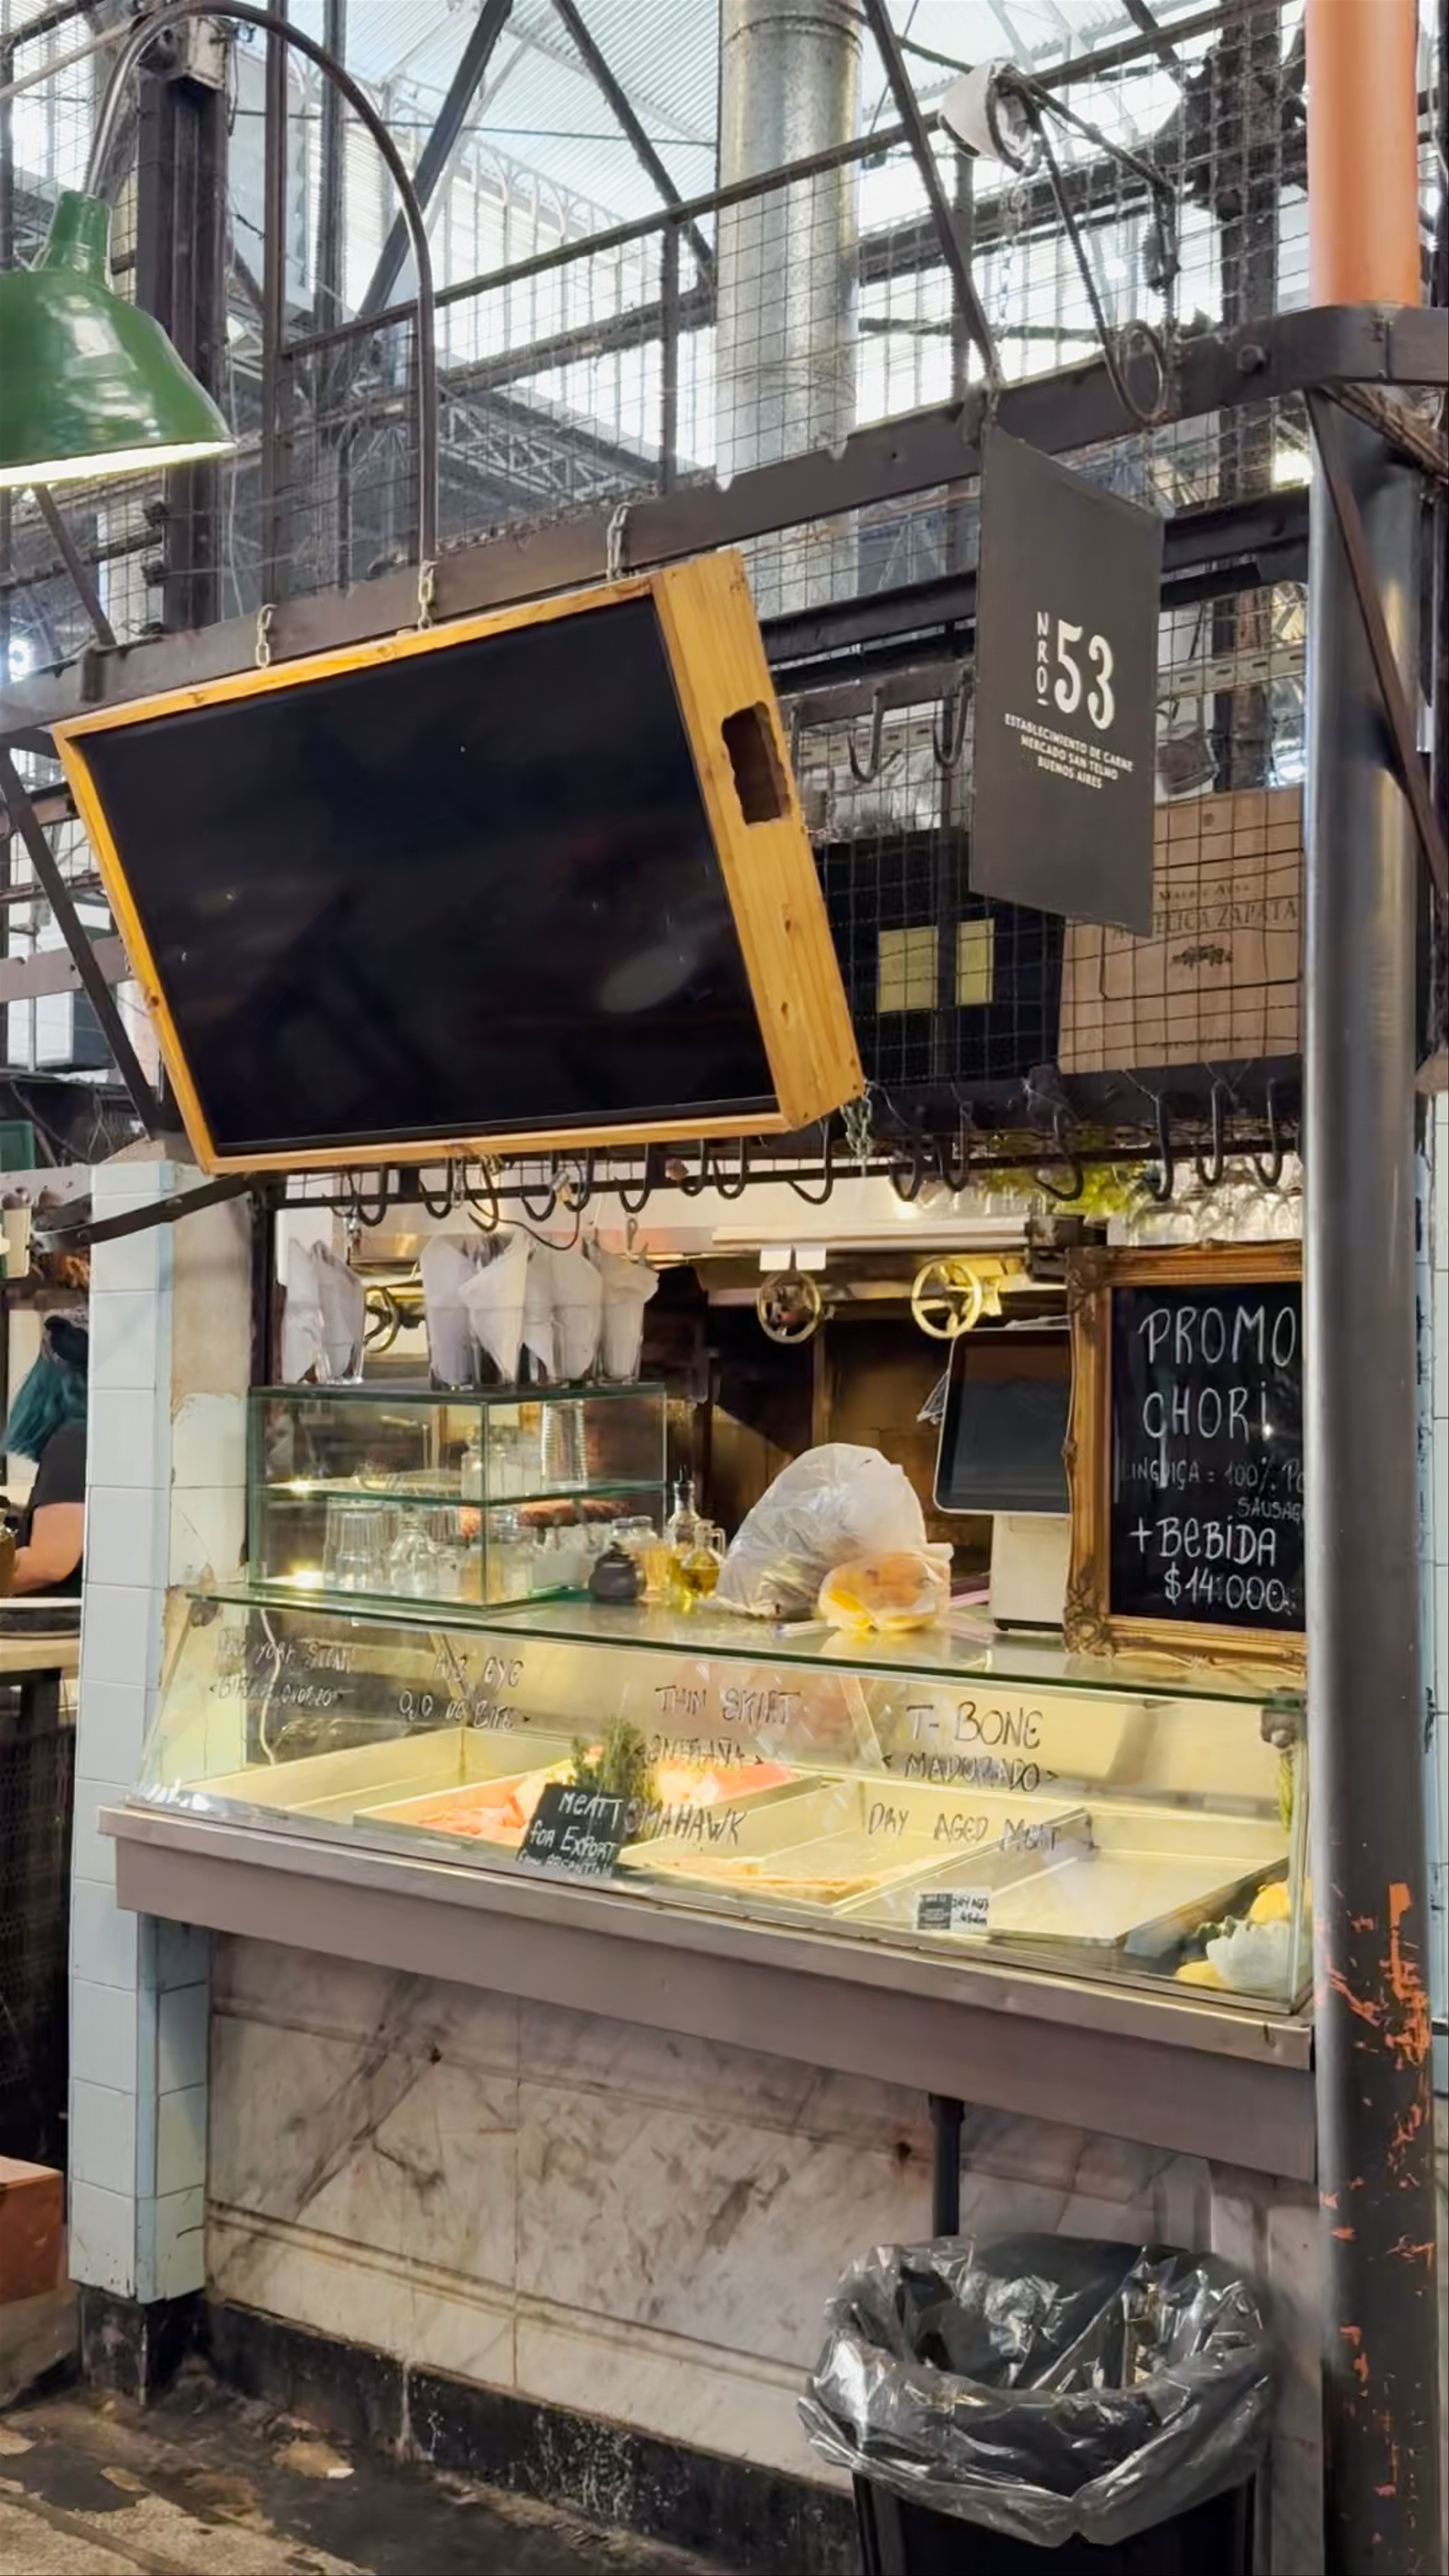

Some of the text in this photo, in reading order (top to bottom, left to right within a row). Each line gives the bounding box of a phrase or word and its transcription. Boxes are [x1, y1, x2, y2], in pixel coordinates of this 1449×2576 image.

[1037, 611, 1115, 730] NRO 53
[1005, 713, 1134, 772] ESTABLECIMIENTO DE CARNE
[1021, 734, 1119, 780] MERCADO SAN TELMO
[1038, 755, 1103, 789] BUENOS AIRES
[1138, 1304, 1296, 1367] PROMO
[1238, 1496, 1304, 1524] SAUSAG
[654, 1685, 801, 1725] THIN SKIRT
[868, 1802, 909, 1836] DRY
[933, 1813, 989, 1843] AGED
